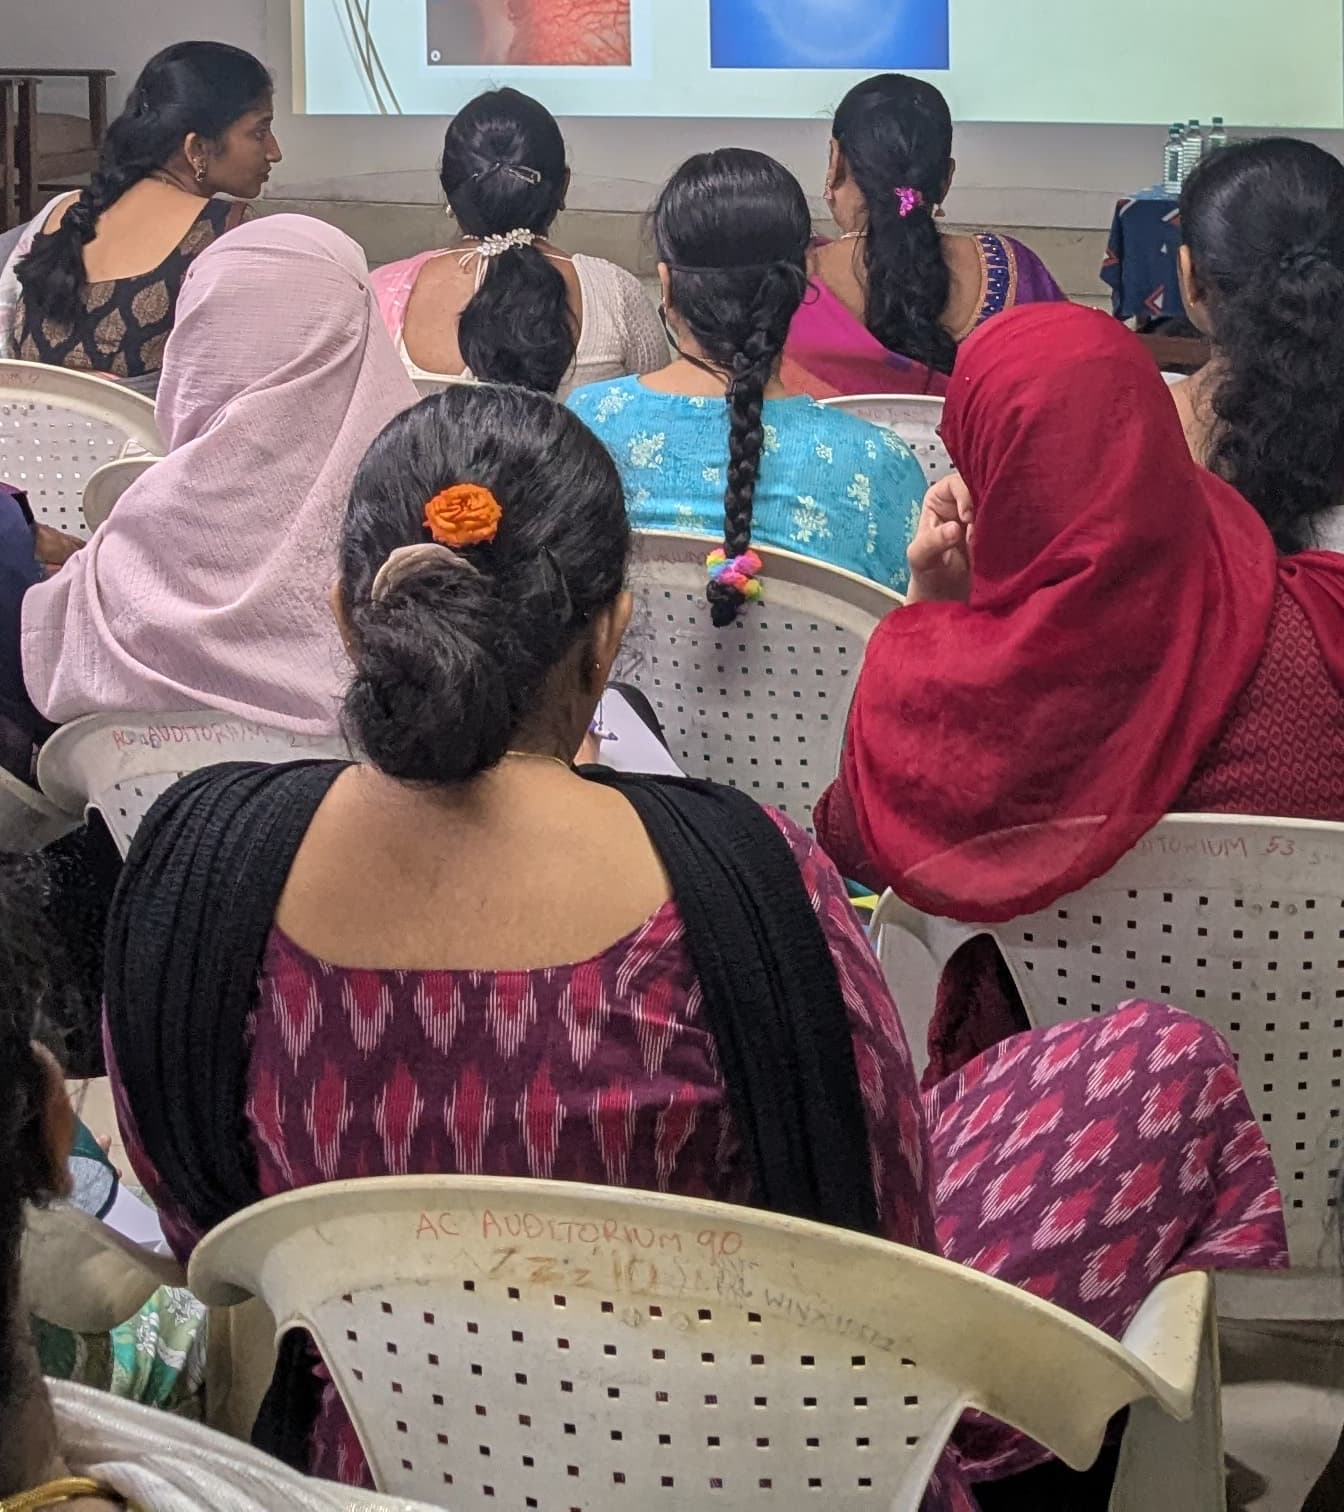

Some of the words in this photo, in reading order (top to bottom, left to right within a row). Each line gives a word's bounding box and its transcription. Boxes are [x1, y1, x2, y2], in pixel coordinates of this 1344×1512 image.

[1265, 835, 1295, 856] 53
[416, 1212, 461, 1240] AC
[482, 1209, 683, 1253] AUDITORIUM
